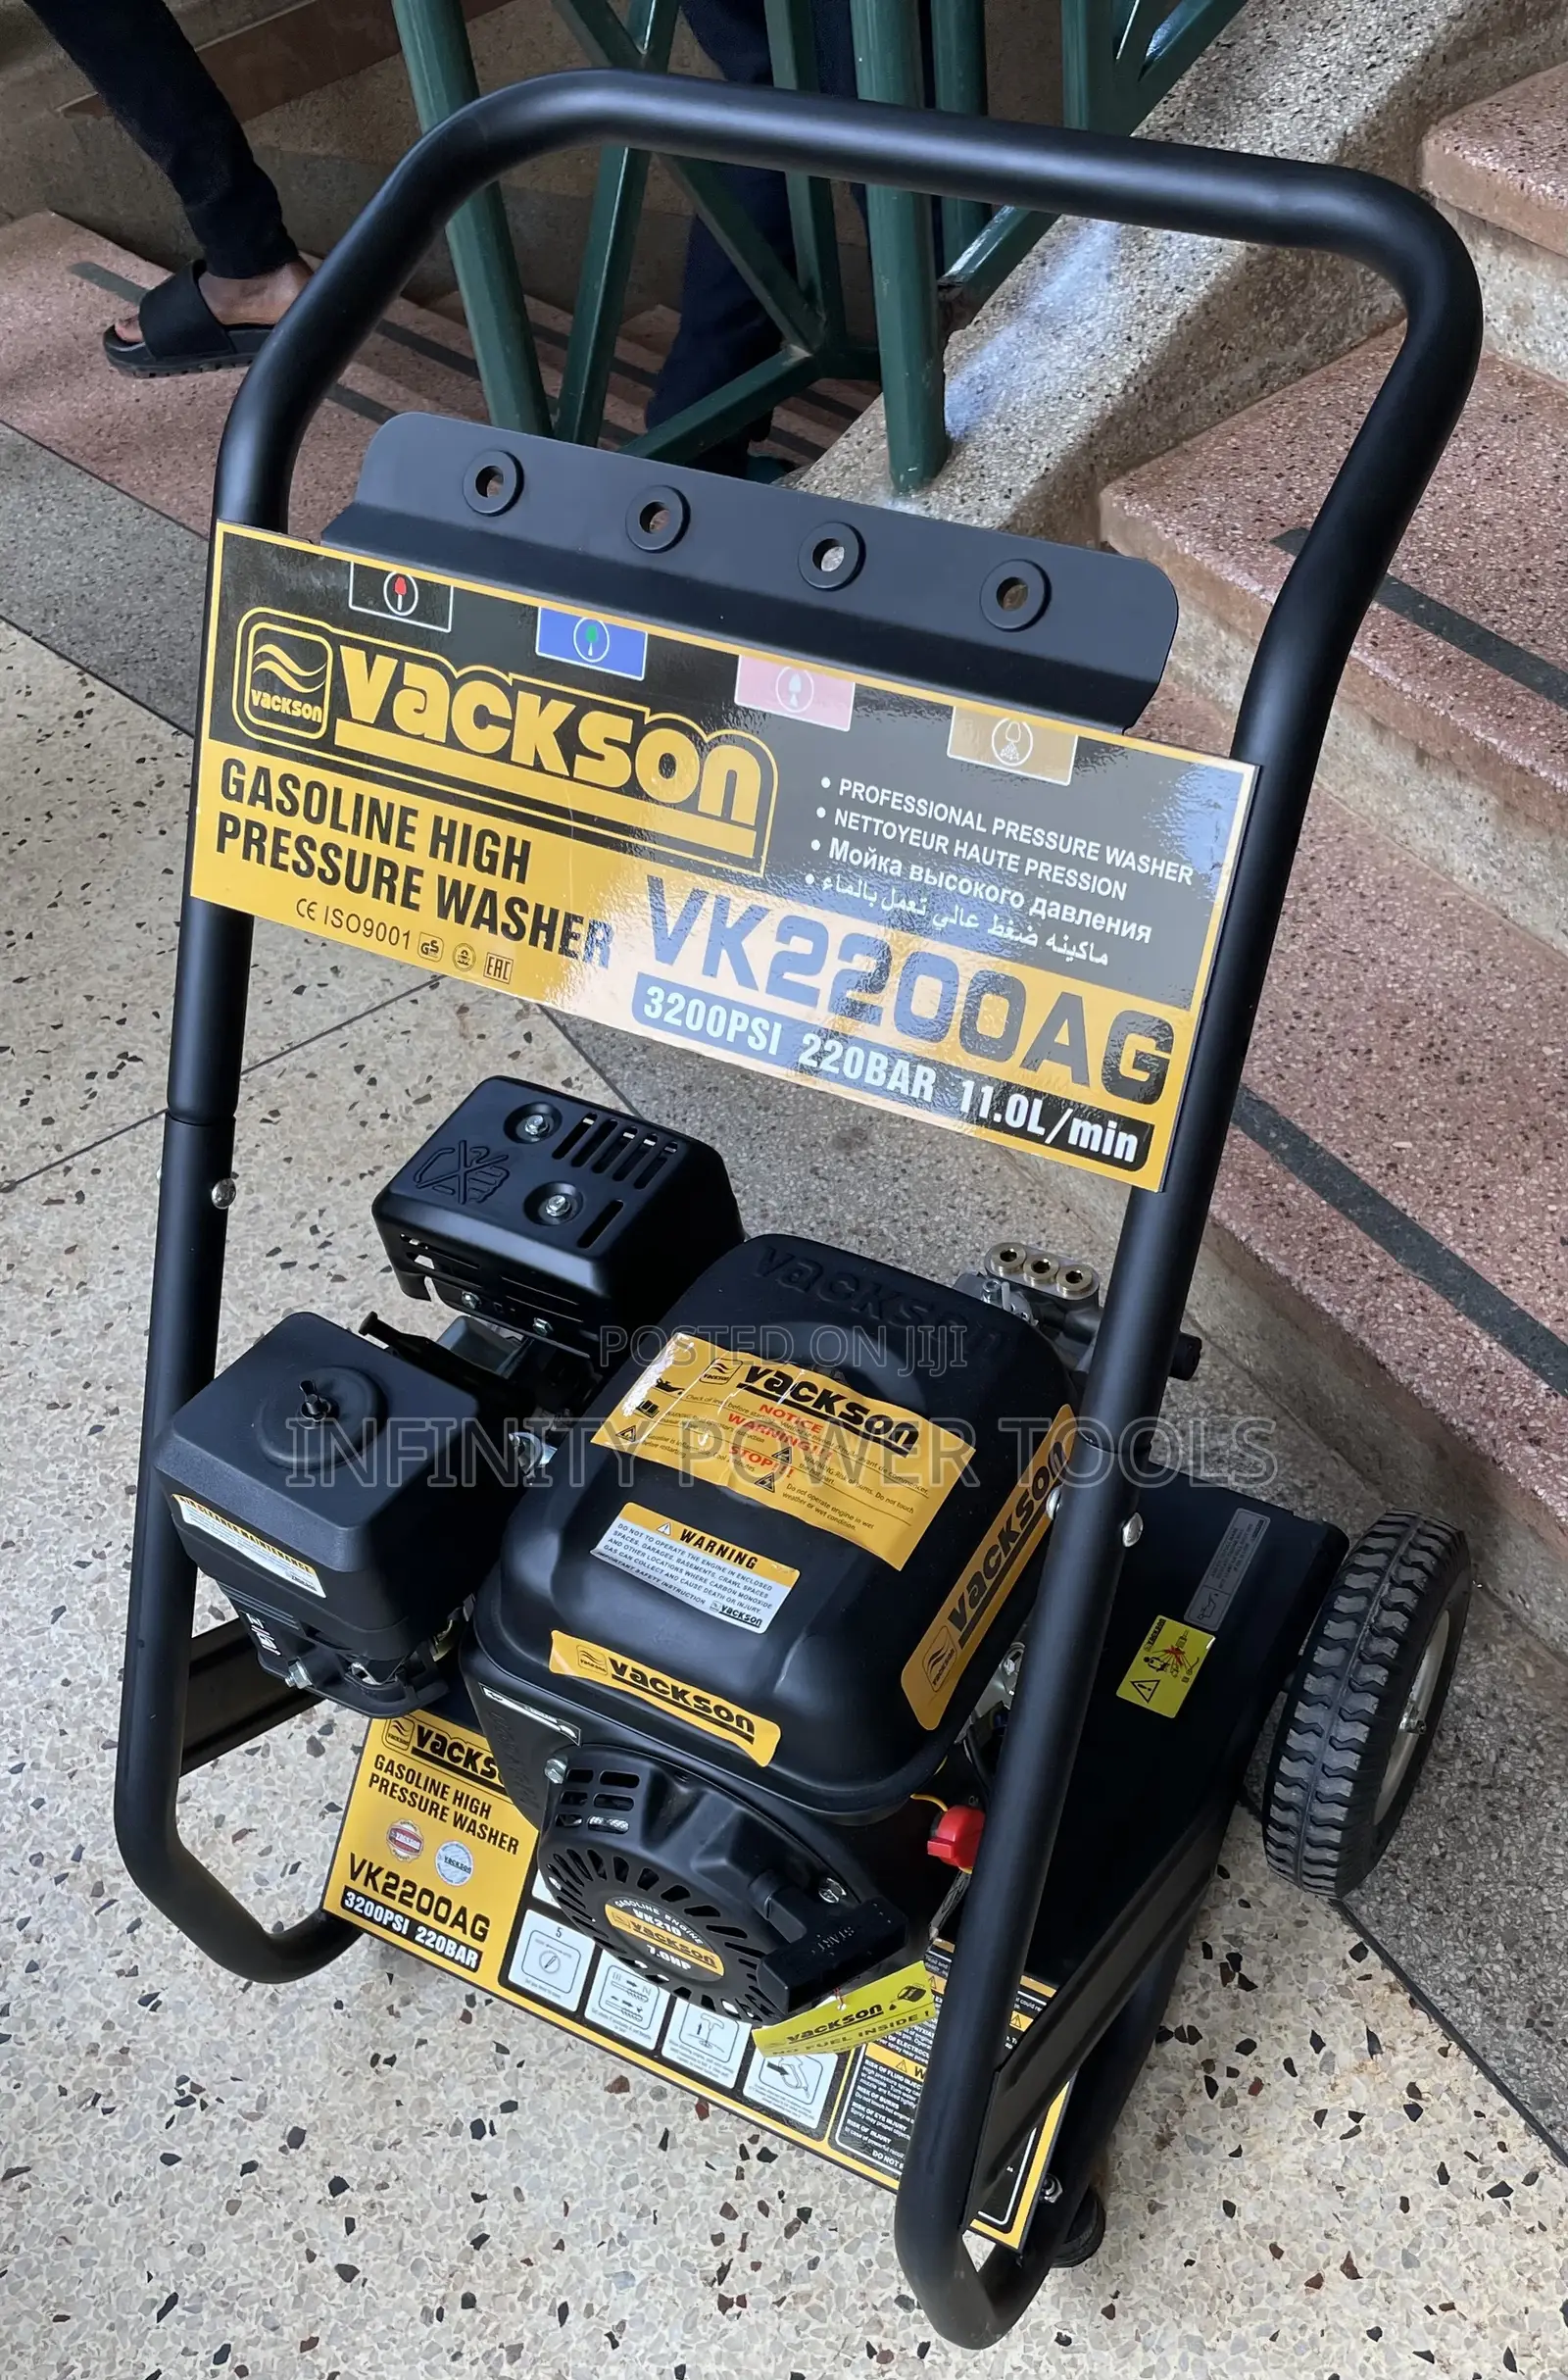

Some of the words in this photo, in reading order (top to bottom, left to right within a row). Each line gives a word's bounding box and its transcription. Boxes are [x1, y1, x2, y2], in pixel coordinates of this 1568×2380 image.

[220, 757, 416, 853] GASOLINE
[427, 819, 531, 884] HIGH
[839, 777, 987, 833] PROFESSIONAL
[992, 817, 1101, 862] PRESSURE
[1104, 849, 1194, 886] WASHER
[834, 808, 949, 855] NETTOYEUR
[953, 839, 1020, 873] HAUTE
[1024, 858, 1128, 902] PRESSION
[216, 811, 422, 912] PRESSURE
[436, 874, 612, 969] WASHER
[829, 837, 903, 878] Мойка
[908, 864, 1026, 910] высокого
[1028, 896, 1152, 944] давления
[323, 905, 412, 950] ISO9001
[647, 874, 1175, 1106] VK2200AG
[643, 984, 782, 1057] 3200PSI
[799, 1032, 938, 1103] 220BAR
[960, 1078, 1139, 1164] 11.0L/min
[759, 1404, 824, 1434] NOTICE
[808, 1491, 831, 1510] operate
[597, 1550, 635, 1570] IMPORTANT
[634, 1567, 661, 1583] SAFETY
[660, 1580, 706, 1605] INSTRUCTION
[603, 1544, 618, 1554] GAS
[617, 1551, 633, 1561] CAN
[632, 1557, 663, 1574] COLLECT
[663, 1571, 679, 1581] AND
[679, 1577, 703, 1591] CAUSE
[703, 1586, 725, 1601] DEATH
[724, 1596, 736, 1605] OR
[608, 1537, 622, 1547] AND
[622, 1544, 646, 1557] OTHER
[646, 1554, 684, 1574] LOCATIONS
[683, 1569, 709, 1584] WHERE
[709, 1579, 738, 1596] CARBON
[627, 1527, 644, 1538] NOT
[654, 1539, 685, 1556] OPERATE
[686, 1552, 701, 1562] THE
[701, 1558, 726, 1572] ENGINE
[735, 1572, 772, 1592] ENCLOSED
[680, 1528, 759, 1570] WARNING
[717, 1574, 742, 1588] CRAWL
[742, 1584, 768, 1599] SPACES
[368, 1772, 448, 1822] PRESSURE
[453, 1810, 519, 1856] WASHER
[373, 1754, 451, 1801] GASOLINE
[452, 1789, 492, 1820] HIGH
[350, 1853, 491, 1943] VK2200AG
[614, 1899, 661, 1916] GASOLINE
[664, 1913, 705, 1946] ENGINE
[344, 1891, 410, 1936] 3200PSI
[415, 1926, 479, 1969] 220BAR
[556, 1927, 564, 1939] 5
[647, 1944, 692, 1971] 7.0HP
[806, 2036, 853, 2052] FUEL
[858, 2014, 919, 2037] INSIDE
